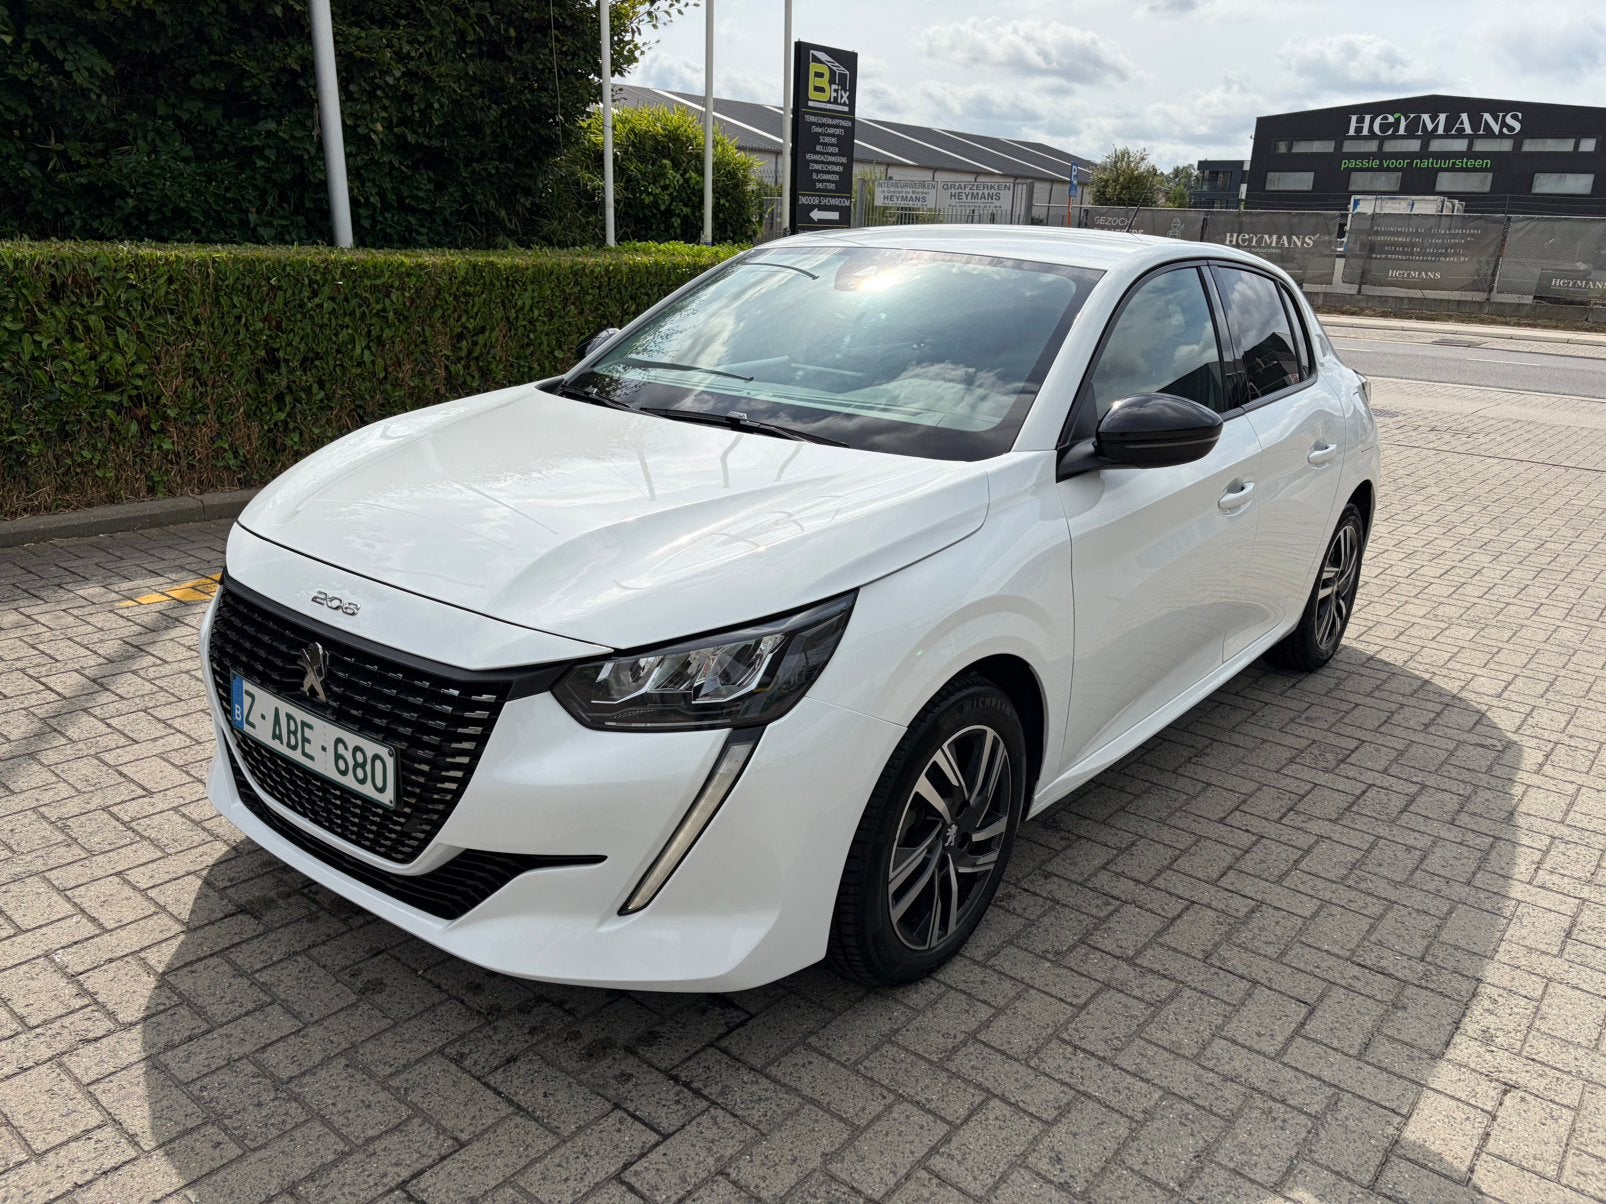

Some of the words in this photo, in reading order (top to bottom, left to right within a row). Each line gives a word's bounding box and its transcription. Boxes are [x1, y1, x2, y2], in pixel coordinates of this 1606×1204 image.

[824, 127, 845, 136] CARPORTS
[819, 136, 837, 144] SCREENS
[815, 144, 839, 153] ROLLUIKEN
[1341, 158, 1380, 171] passie
[1382, 159, 1411, 169] voor
[1413, 157, 1491, 169] natuursteen
[1071, 165, 1078, 181] P
[876, 181, 936, 190] INTERIEURWERKEN
[942, 183, 1011, 191] GRAFZERKEN
[798, 195, 819, 204] INDOOR
[820, 196, 851, 206] SHOWROOM
[883, 194, 927, 203] HEYMANS
[950, 191, 1001, 201] HEYMANS
[311, 590, 361, 617] 208
[234, 704, 242, 721] B
[243, 690, 388, 794] Z-ABE-680
